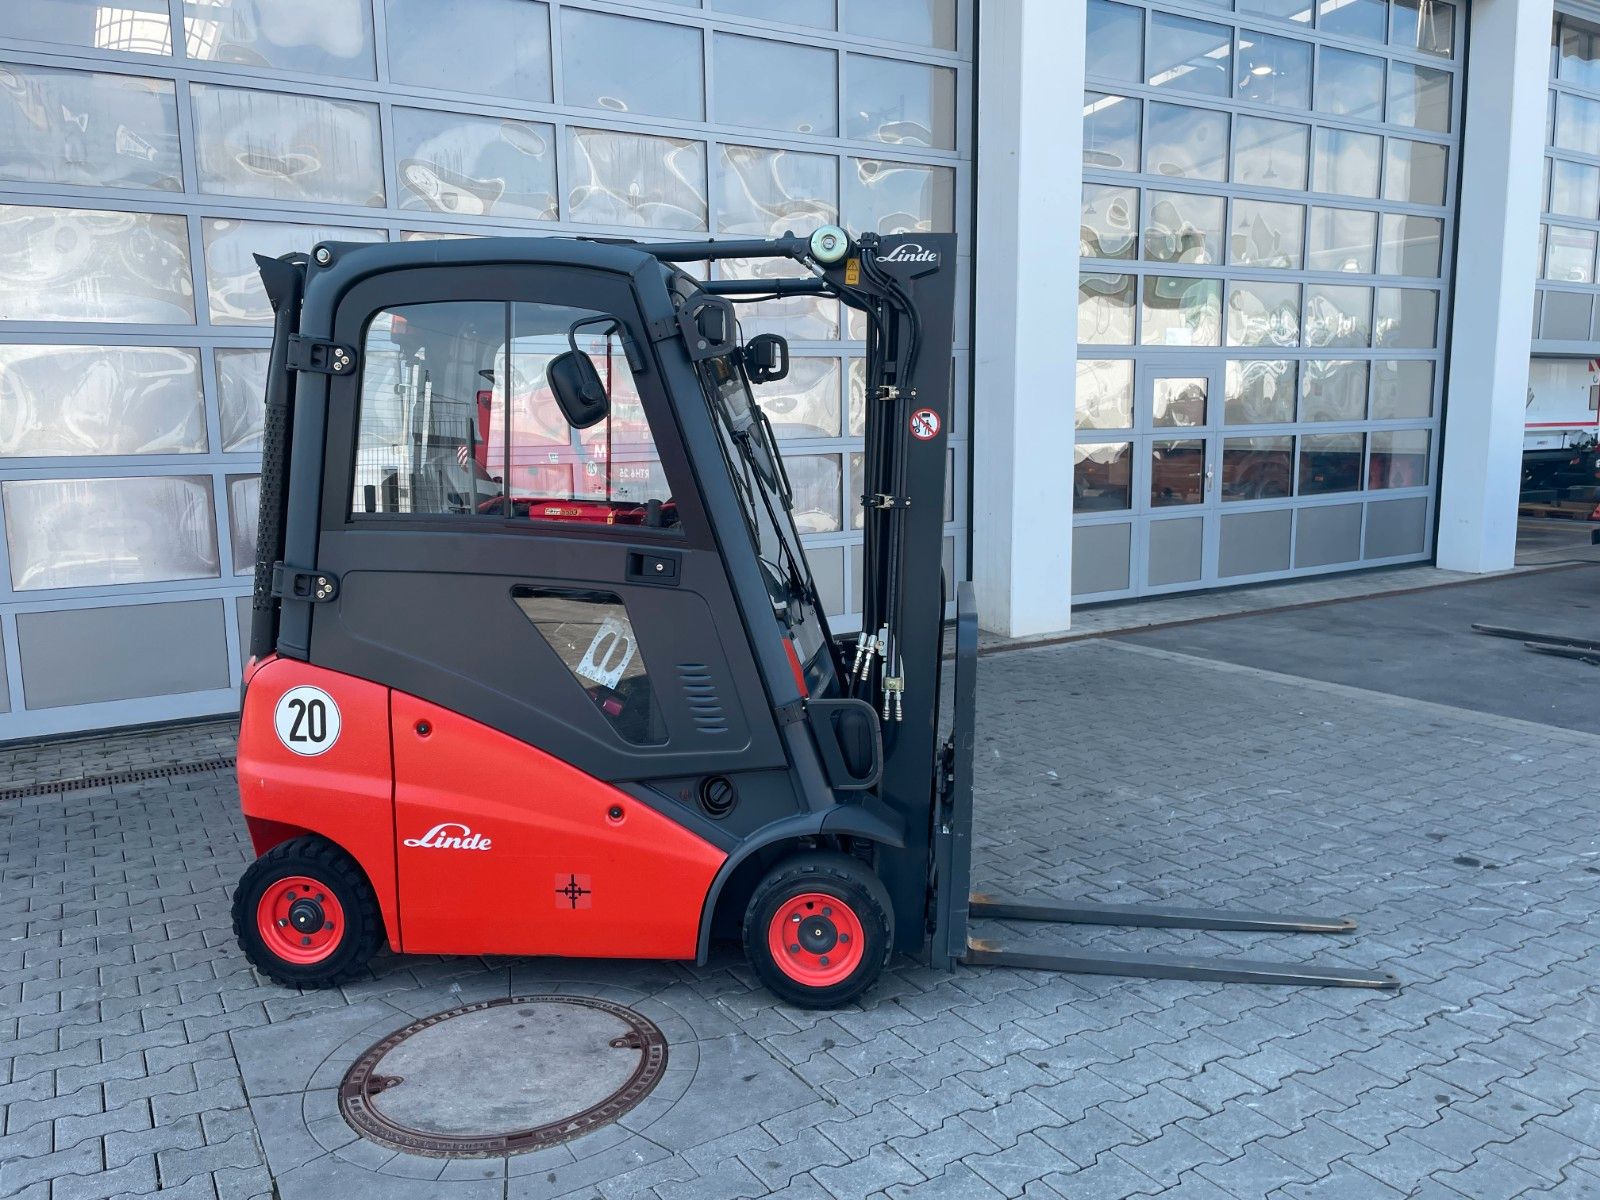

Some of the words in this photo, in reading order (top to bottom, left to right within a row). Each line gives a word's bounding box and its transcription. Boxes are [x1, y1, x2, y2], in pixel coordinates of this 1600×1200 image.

[876, 243, 937, 263] Linde
[287, 698, 327, 743] 20
[403, 822, 492, 851] Linde
